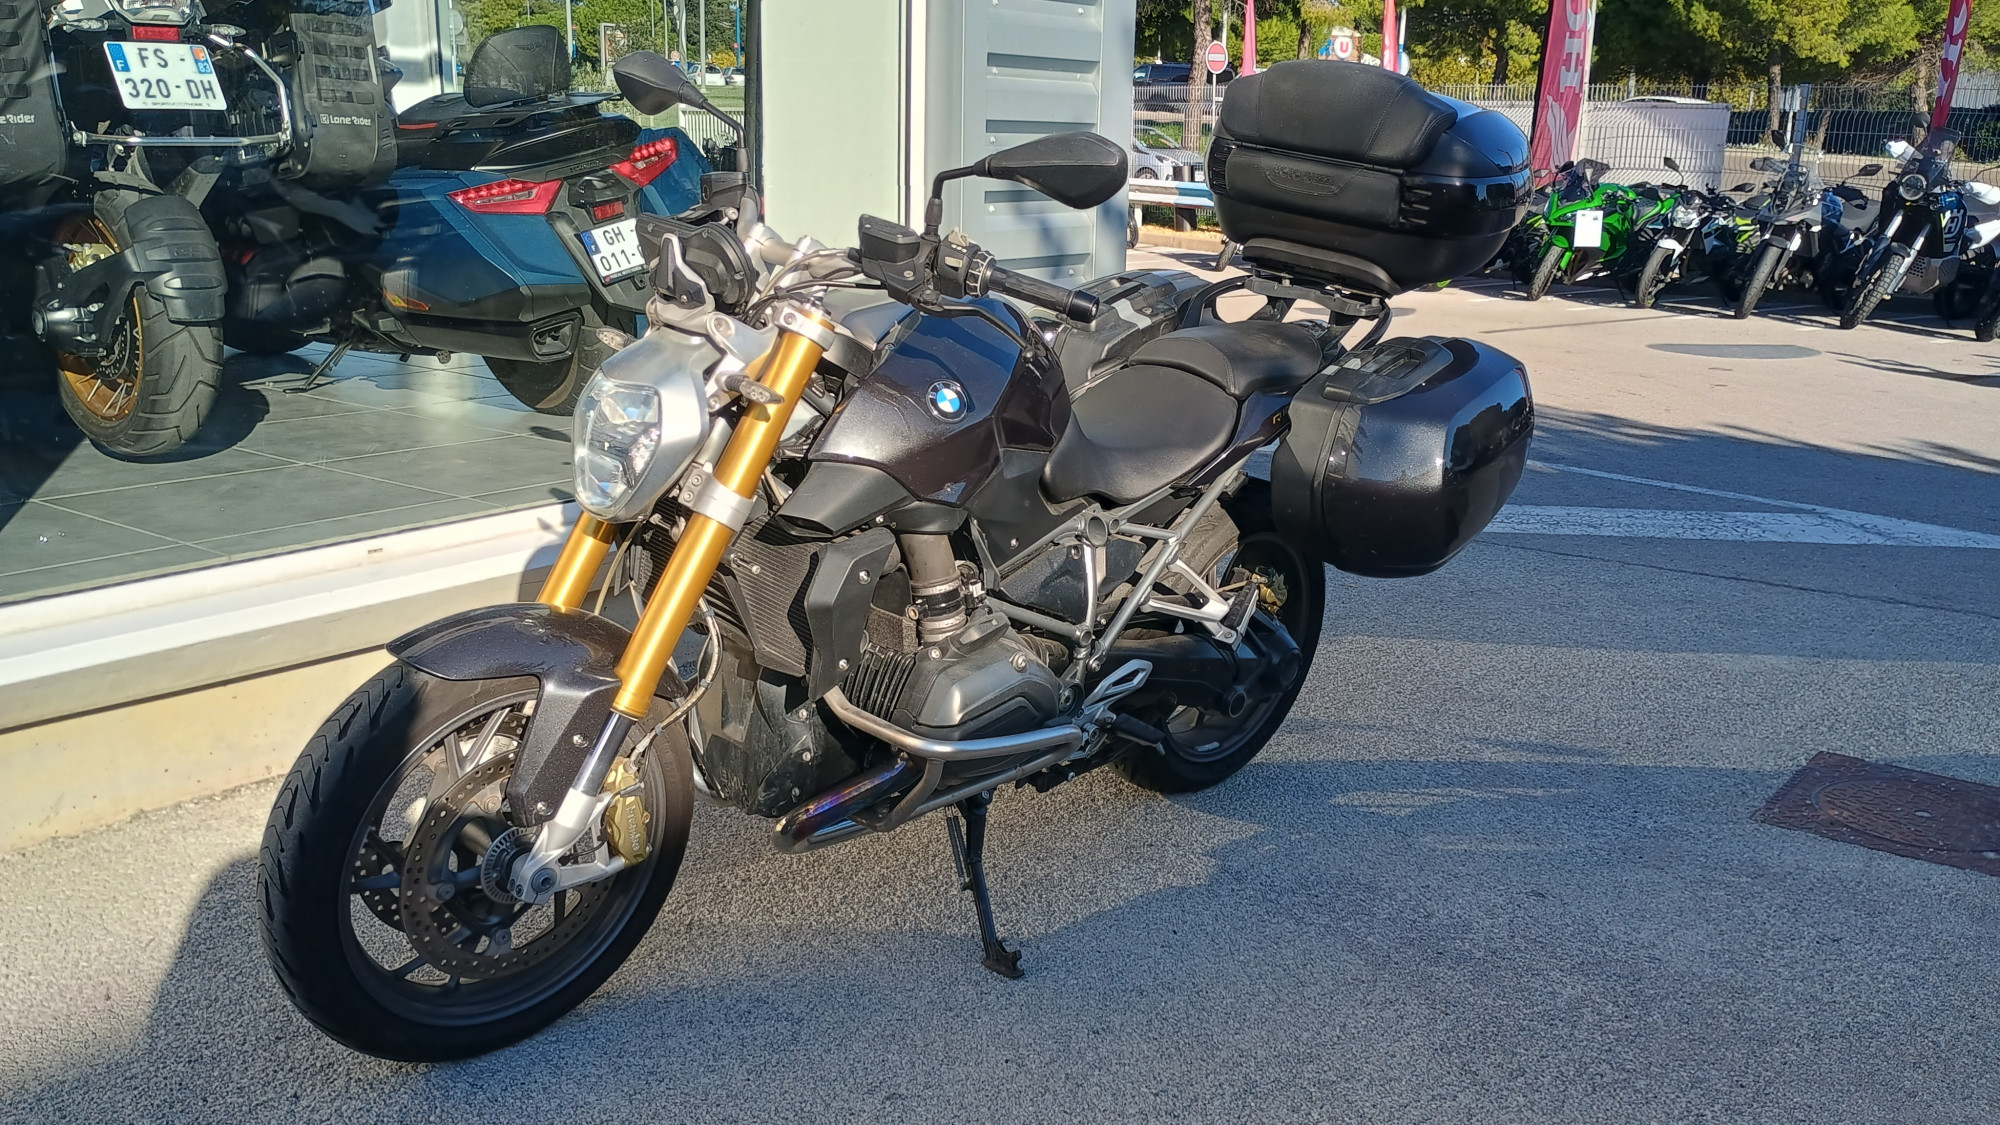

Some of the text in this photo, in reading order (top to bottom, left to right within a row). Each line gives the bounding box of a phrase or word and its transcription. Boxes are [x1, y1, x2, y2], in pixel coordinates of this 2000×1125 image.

[116, 60, 125, 70] F
[198, 62, 211, 73] 83
[124, 78, 217, 100] 320-DH
[330, 114, 371, 126] Lone Rider
[929, 382, 958, 400] BMW
